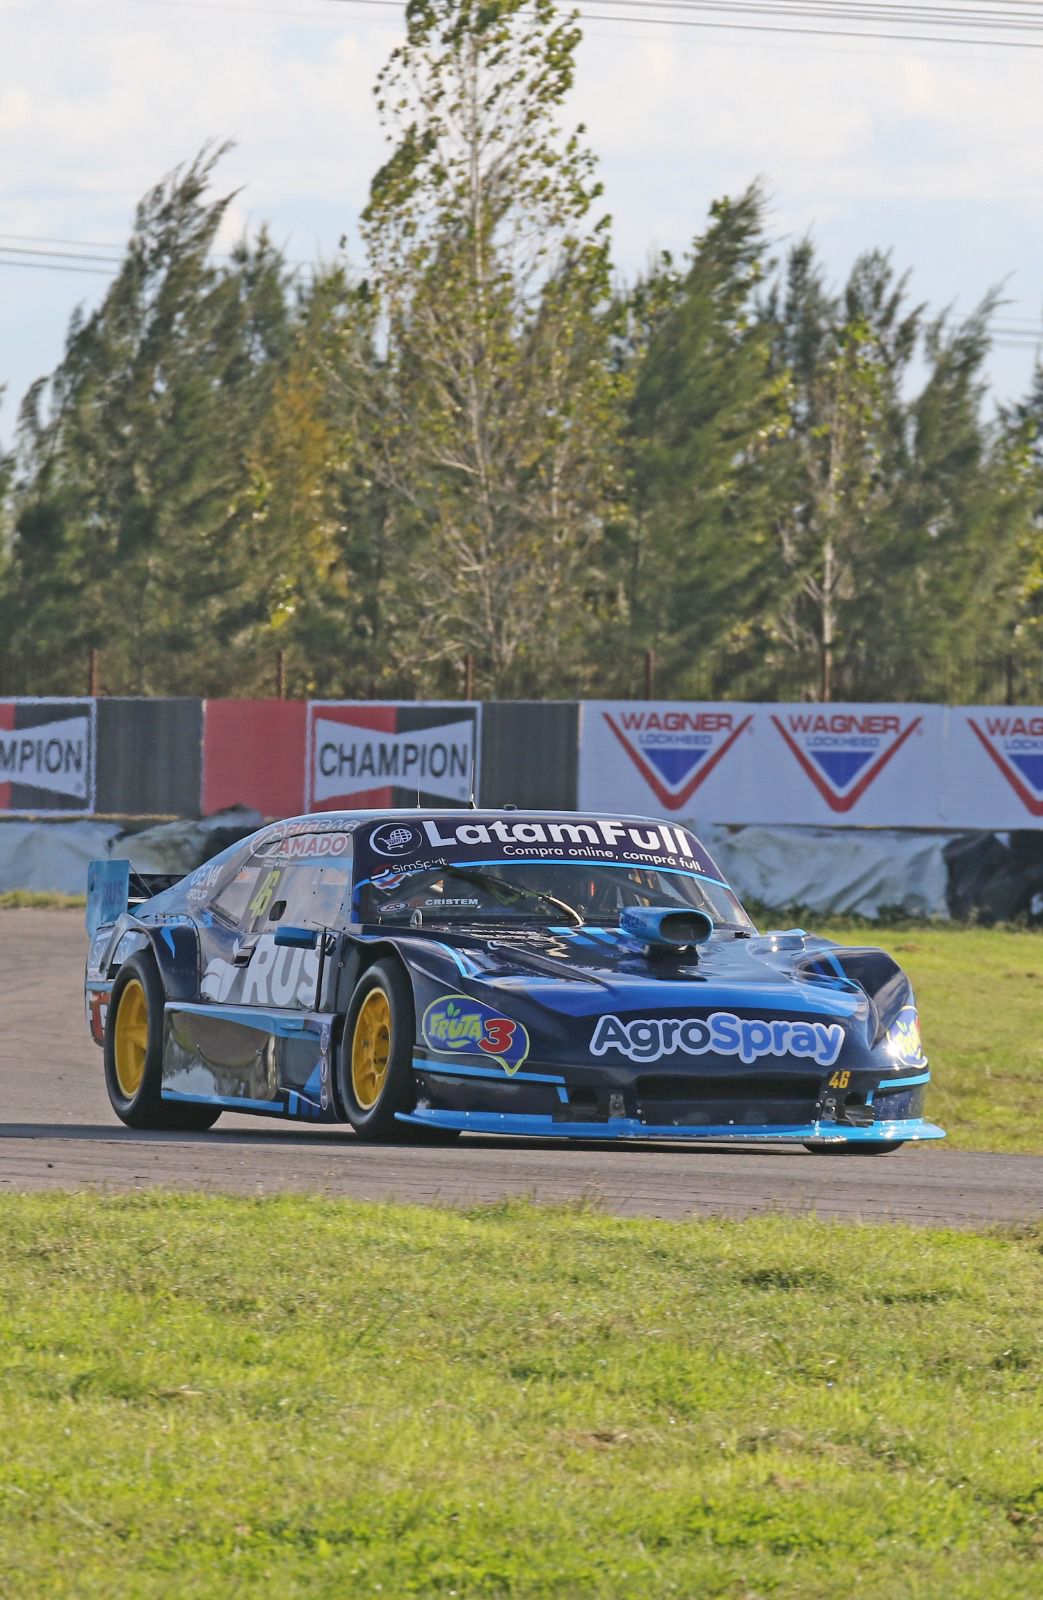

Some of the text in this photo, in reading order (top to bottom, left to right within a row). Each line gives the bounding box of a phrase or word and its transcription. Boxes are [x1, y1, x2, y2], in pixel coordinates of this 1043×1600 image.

[620, 712, 733, 731] WAGNER
[789, 714, 900, 734] WAGNER
[984, 717, 1043, 736] WAG
[638, 734, 712, 745] LOCKHEED
[806, 736, 880, 748] LOCKHEED
[319, 742, 468, 778] CHAMPION
[421, 820, 694, 858] LatamFull
[503, 845, 706, 873] Compra online, comprá full.
[425, 898, 479, 906] CRISTEM
[429, 1012, 517, 1054] FRUTA 3
[591, 1012, 845, 1066] AgroSpray
[829, 1071, 851, 1089] 46
